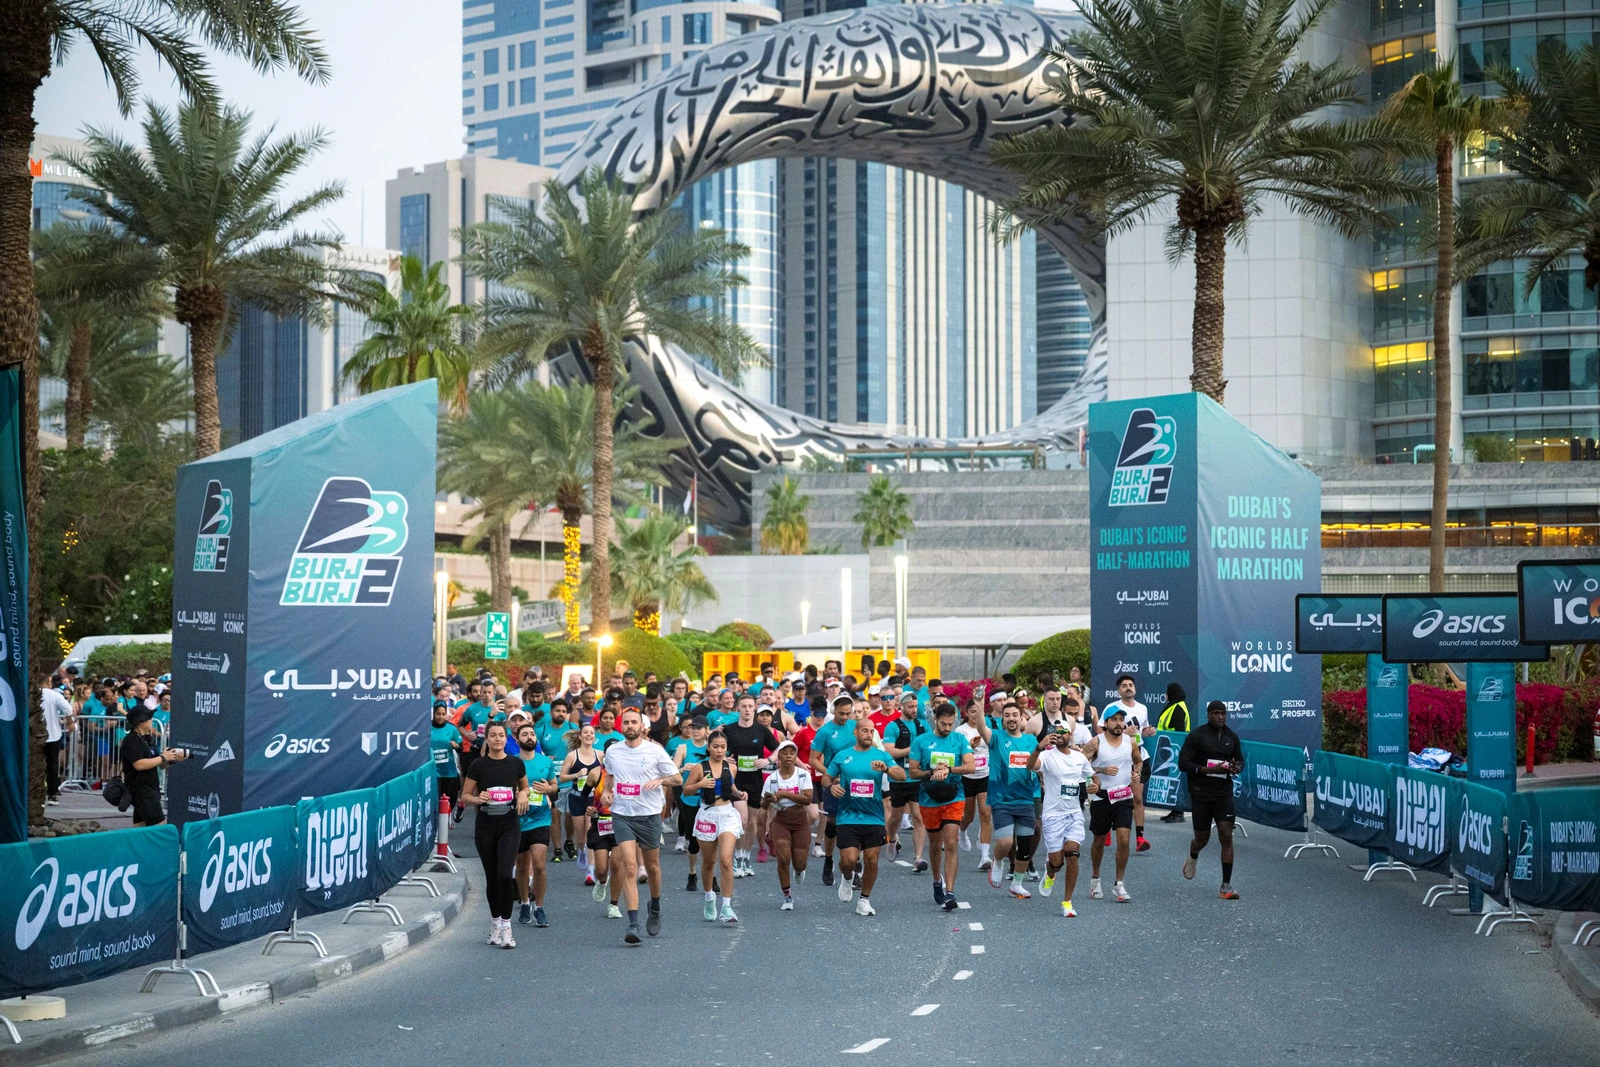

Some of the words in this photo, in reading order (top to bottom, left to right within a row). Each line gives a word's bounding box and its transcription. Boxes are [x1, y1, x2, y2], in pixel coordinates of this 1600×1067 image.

[1114, 468, 1152, 486] BURJ
[1110, 487, 1149, 504] BURJ
[3, 510, 15, 545] body
[1147, 525, 1187, 545] ICONIC
[197, 537, 217, 554] BURJ
[1211, 526, 1265, 549] ICONIC
[1271, 527, 1309, 550] HALF
[4, 545, 17, 587] sound
[195, 555, 215, 570] BURJ
[289, 557, 363, 580] BURJ
[1097, 550, 1190, 570] HALF-MARATHON
[1217, 557, 1303, 580] MARATHON
[282, 581, 357, 604] BURJ
[223, 621, 245, 634] ICONIC
[1443, 615, 1507, 633] asics
[13, 625, 23, 668] sound
[1125, 632, 1160, 644] ICONIC
[1231, 641, 1292, 651] WORLDS
[1460, 639, 1478, 647] mind,
[1502, 638, 1520, 647] body
[1156, 661, 1173, 675] JTC
[1231, 653, 1293, 673] ICONIC
[1282, 699, 1306, 708] SEIKO
[1282, 709, 1316, 718] PROSPEX
[286, 738, 331, 754] asics
[381, 731, 419, 756] JTC
[1149, 777, 1169, 791] BURJ
[1147, 790, 1168, 804] BURJ
[1468, 809, 1492, 855] asics
[224, 836, 272, 894] asics
[57, 863, 139, 928] asics
[220, 911, 239, 930] sound
[252, 902, 270, 922] sound
[50, 950, 77, 970] sound
[103, 935, 131, 958] sound
